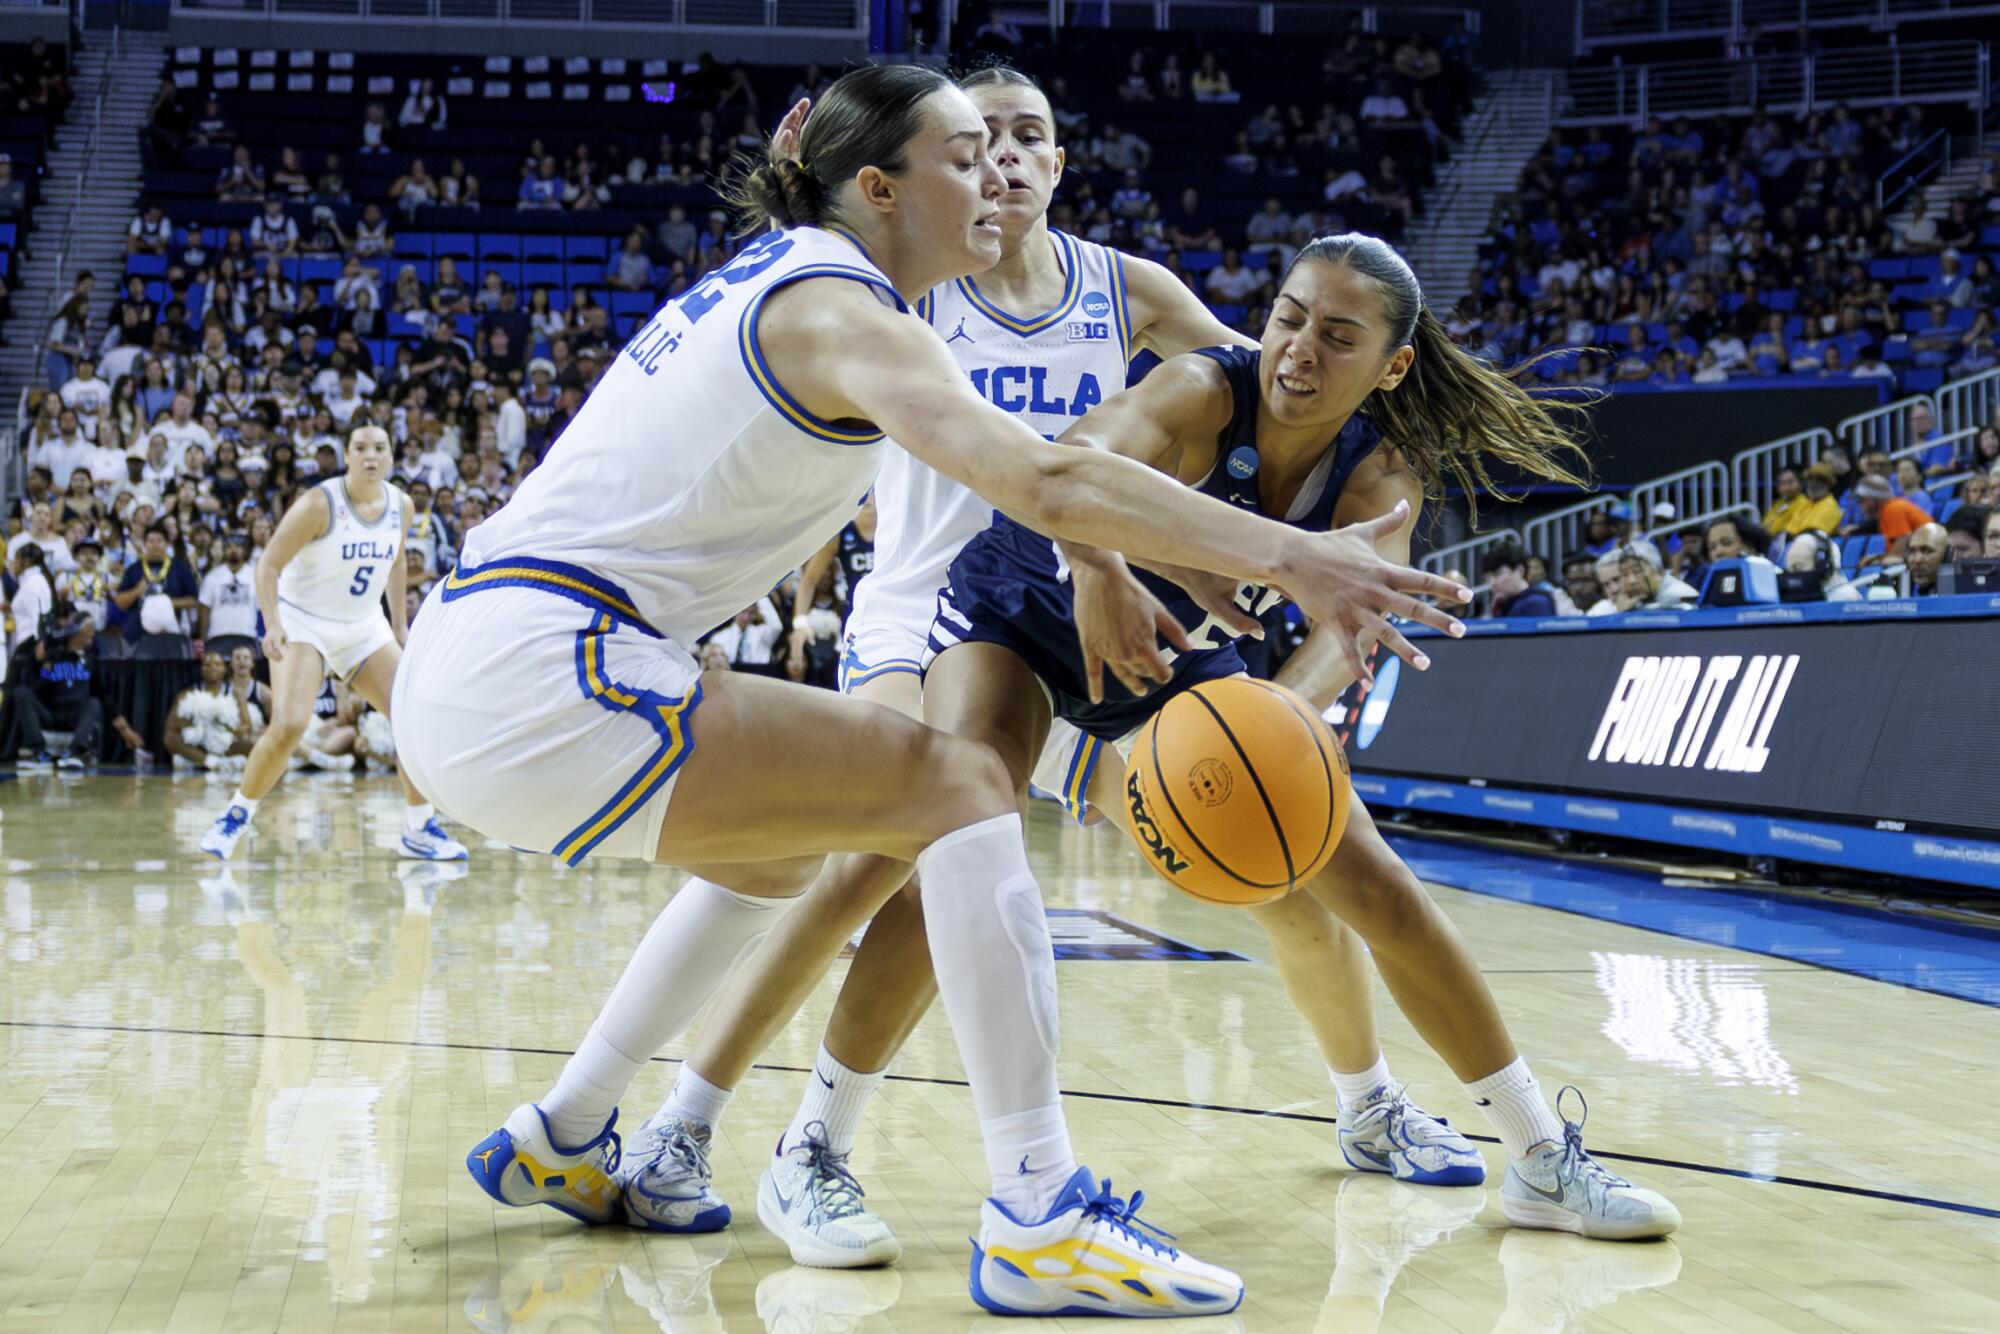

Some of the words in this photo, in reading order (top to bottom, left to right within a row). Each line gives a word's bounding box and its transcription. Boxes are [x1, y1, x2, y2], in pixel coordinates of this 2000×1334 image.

[624, 318, 683, 376] LIĆ
[1230, 456, 1256, 477] NCAA
[342, 541, 394, 561] UCLA
[349, 565, 375, 597] 5
[1587, 655, 1702, 766] FOUR
[1668, 655, 1743, 768] IT
[1703, 654, 1800, 773] ALL
[1127, 769, 1190, 875] NCAA
